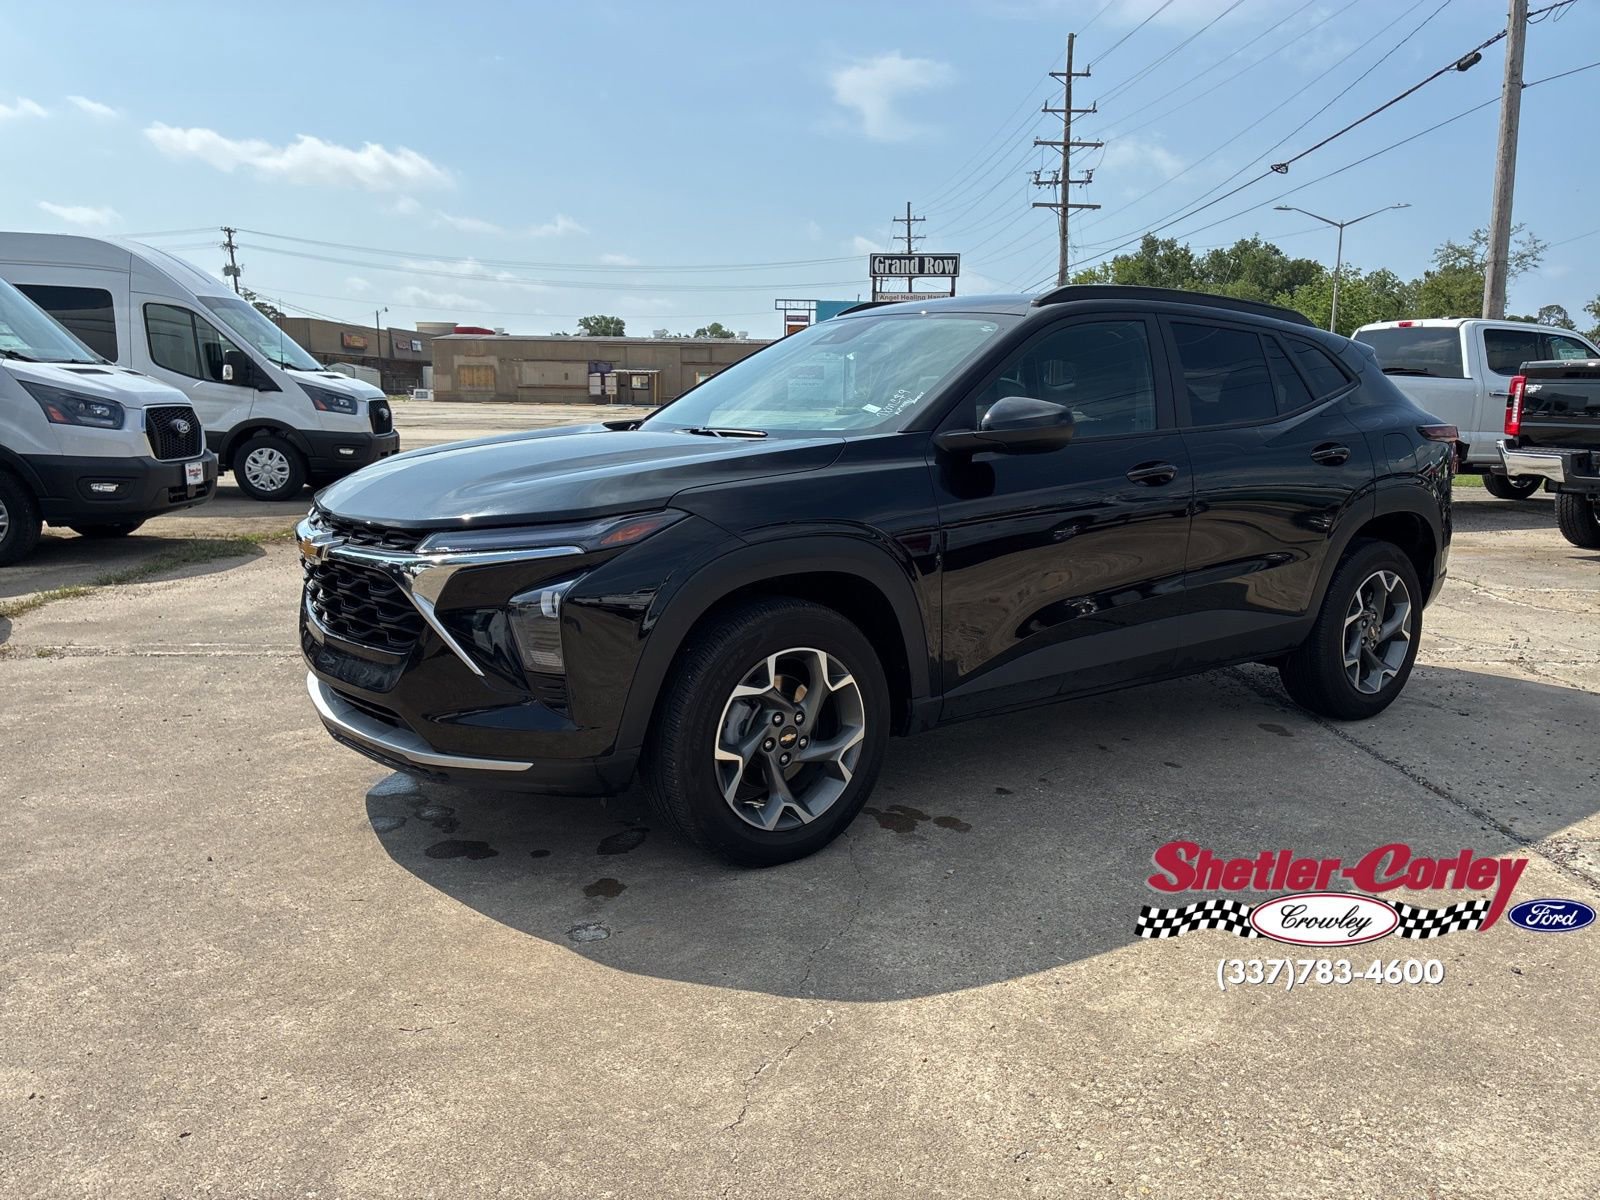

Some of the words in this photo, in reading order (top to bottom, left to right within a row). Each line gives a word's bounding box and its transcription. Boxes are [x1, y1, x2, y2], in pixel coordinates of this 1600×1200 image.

[874, 256, 919, 274] Grand
[924, 257, 956, 274] Row
[880, 294, 899, 302] Angel
